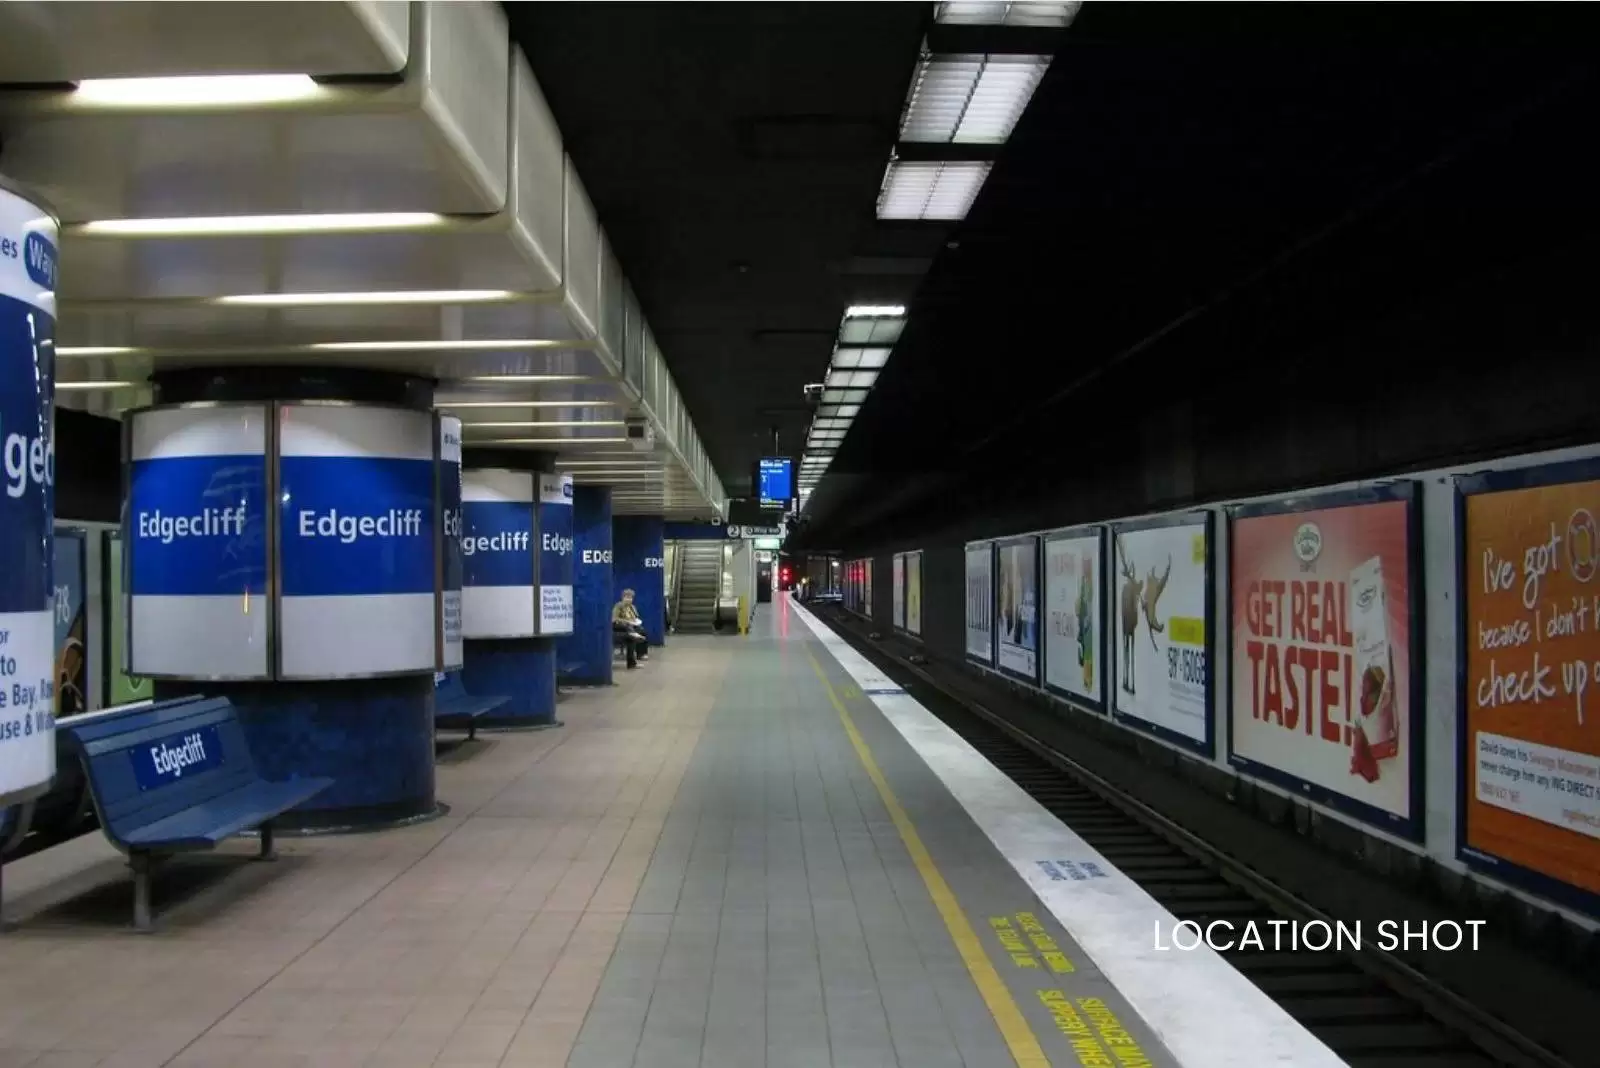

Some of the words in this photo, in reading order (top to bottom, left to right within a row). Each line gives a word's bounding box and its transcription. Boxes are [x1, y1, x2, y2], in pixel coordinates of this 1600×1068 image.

[139, 507, 246, 544] Edgecliff
[299, 509, 422, 543] Edgecliff
[1483, 548, 1515, 593] I've
[1523, 522, 1561, 610] got
[1246, 580, 1286, 639] GET
[1291, 580, 1353, 647] REAL
[1479, 621, 1530, 650] because
[1535, 610, 1541, 642] I
[1547, 597, 1588, 638] don't
[1247, 640, 1354, 747] TASTE!
[1478, 652, 1556, 708] check
[1562, 659, 1588, 725] up
[151, 732, 207, 777] Edgecliff
